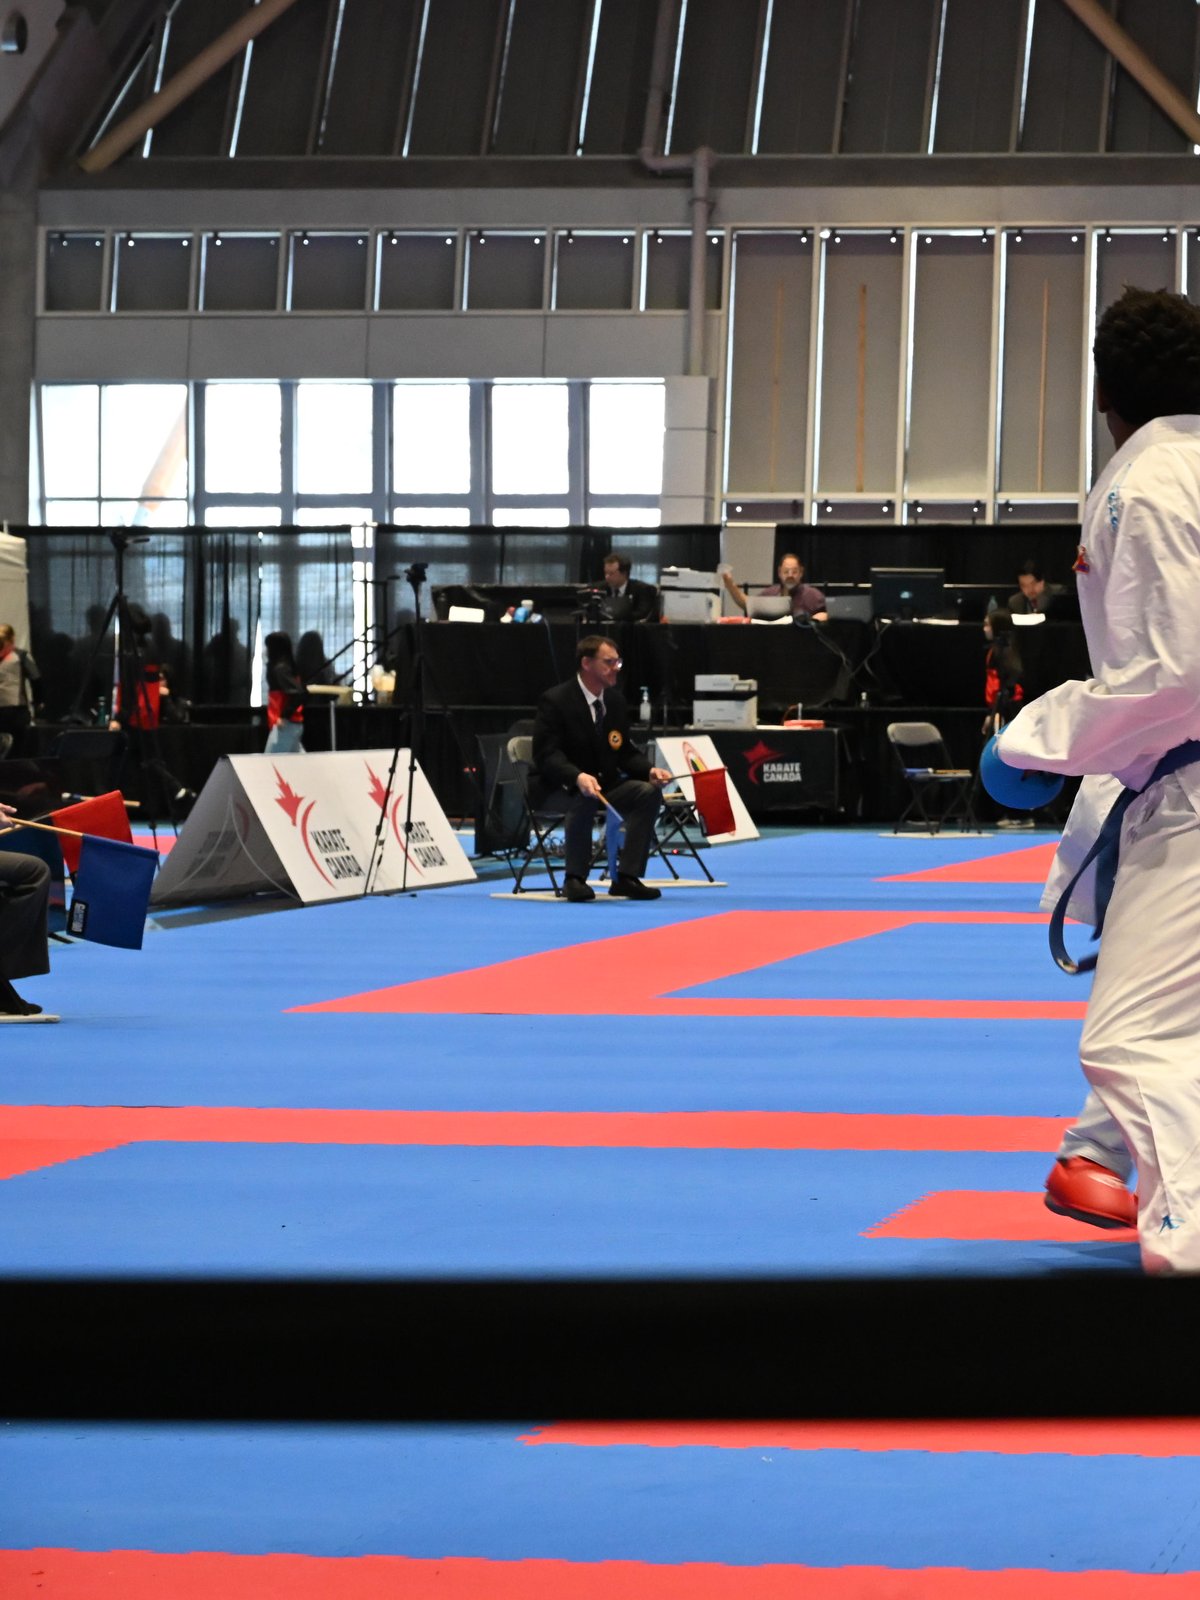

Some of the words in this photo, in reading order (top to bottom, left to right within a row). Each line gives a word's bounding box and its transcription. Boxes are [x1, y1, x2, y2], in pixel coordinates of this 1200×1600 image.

[763, 762, 801, 772] KARATE
[763, 772, 802, 782] CANADA
[310, 828, 350, 854] KARATE
[325, 854, 366, 880] CANADA
[413, 845, 448, 868] CANADA
